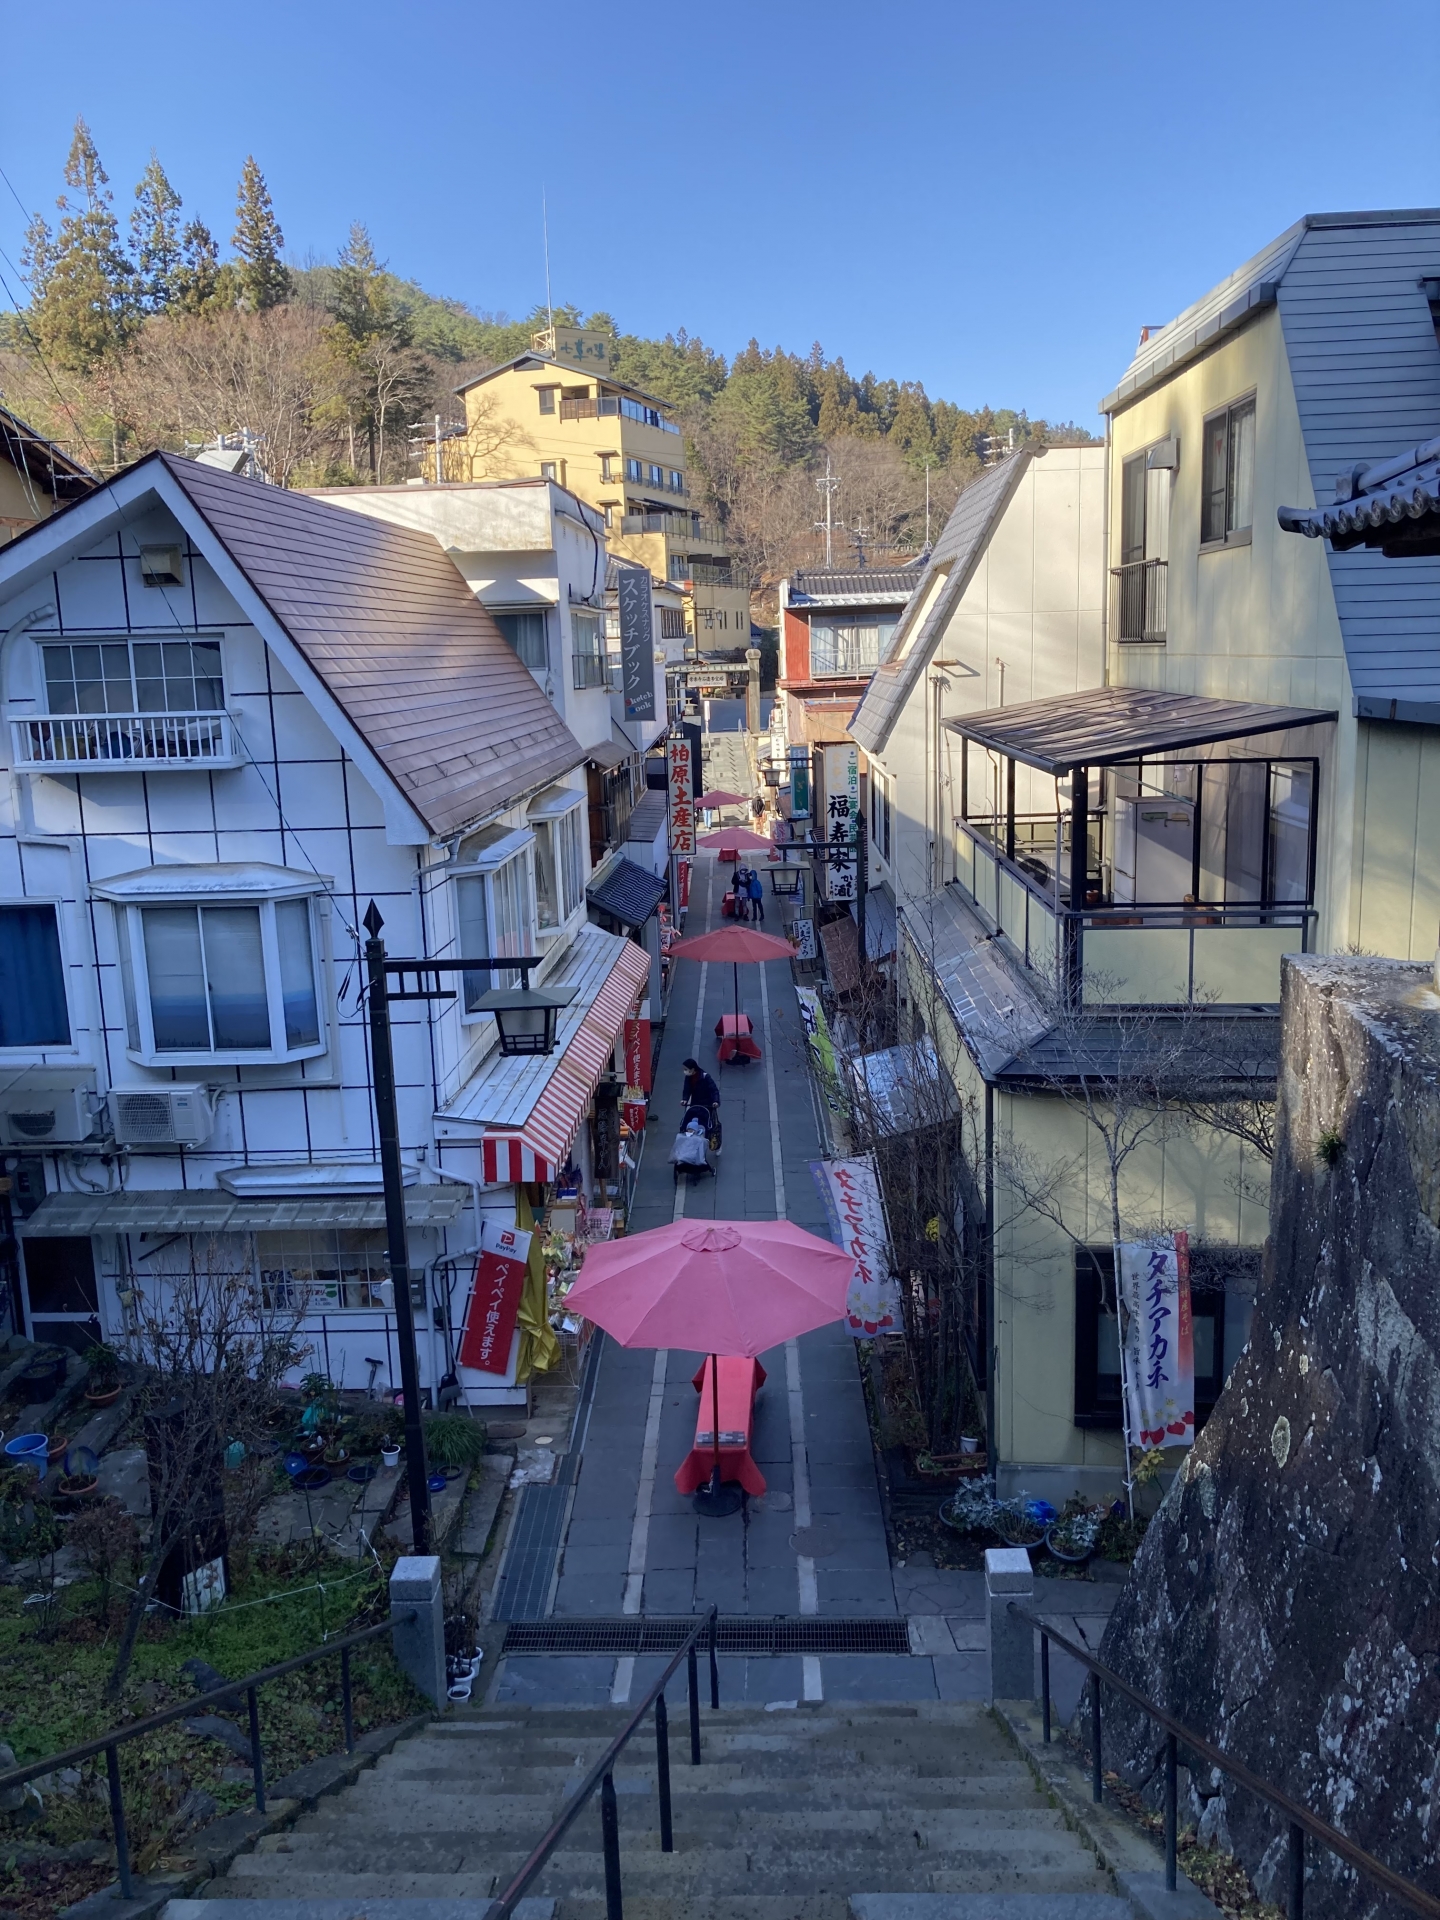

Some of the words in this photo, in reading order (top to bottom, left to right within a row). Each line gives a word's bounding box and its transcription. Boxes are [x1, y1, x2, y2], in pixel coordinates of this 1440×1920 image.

[560, 338, 605, 362] 七草の湯
[622, 578, 641, 691] スケッチブック
[640, 576, 650, 642] カラオケスナック
[625, 691, 654, 707] Sketch
[669, 743, 693, 852] 柏原土産店
[827, 794, 851, 873] 福寿家
[495, 1242, 518, 1255] PayPay
[1179, 1245, 1191, 1336] 青木特産そば
[480, 1264, 509, 1366] ペイペイ使えます。
[1145, 1251, 1172, 1390] タチアカネ
